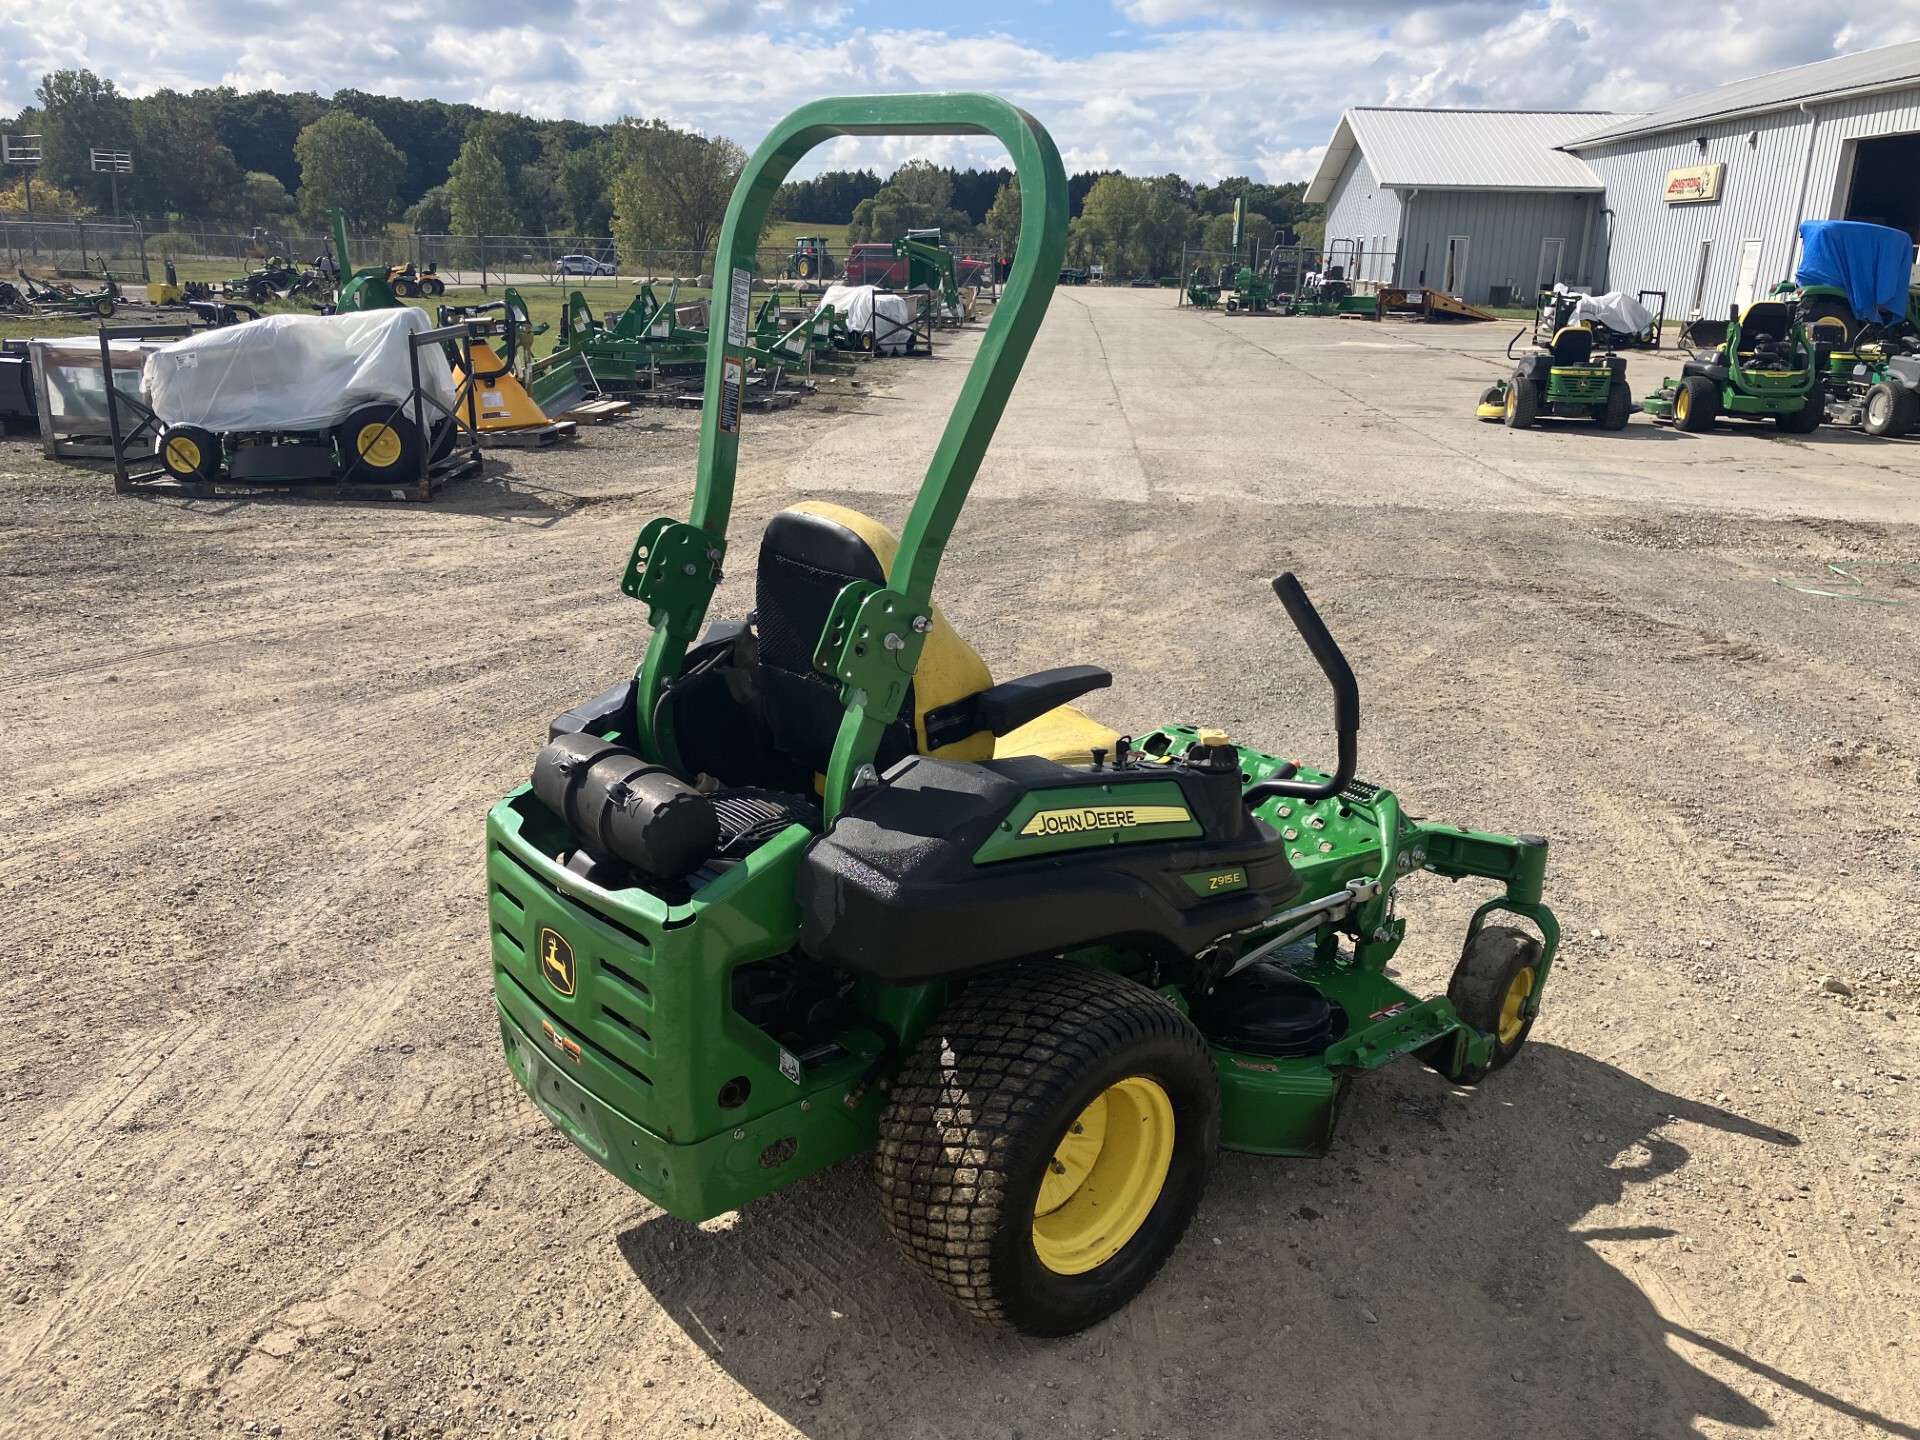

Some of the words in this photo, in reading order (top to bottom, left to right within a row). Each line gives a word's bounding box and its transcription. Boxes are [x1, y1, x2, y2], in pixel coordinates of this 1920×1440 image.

[1038, 814, 1083, 833] JOHN
[1083, 810, 1136, 827] DEERE
[1209, 873, 1241, 890] Z915E
